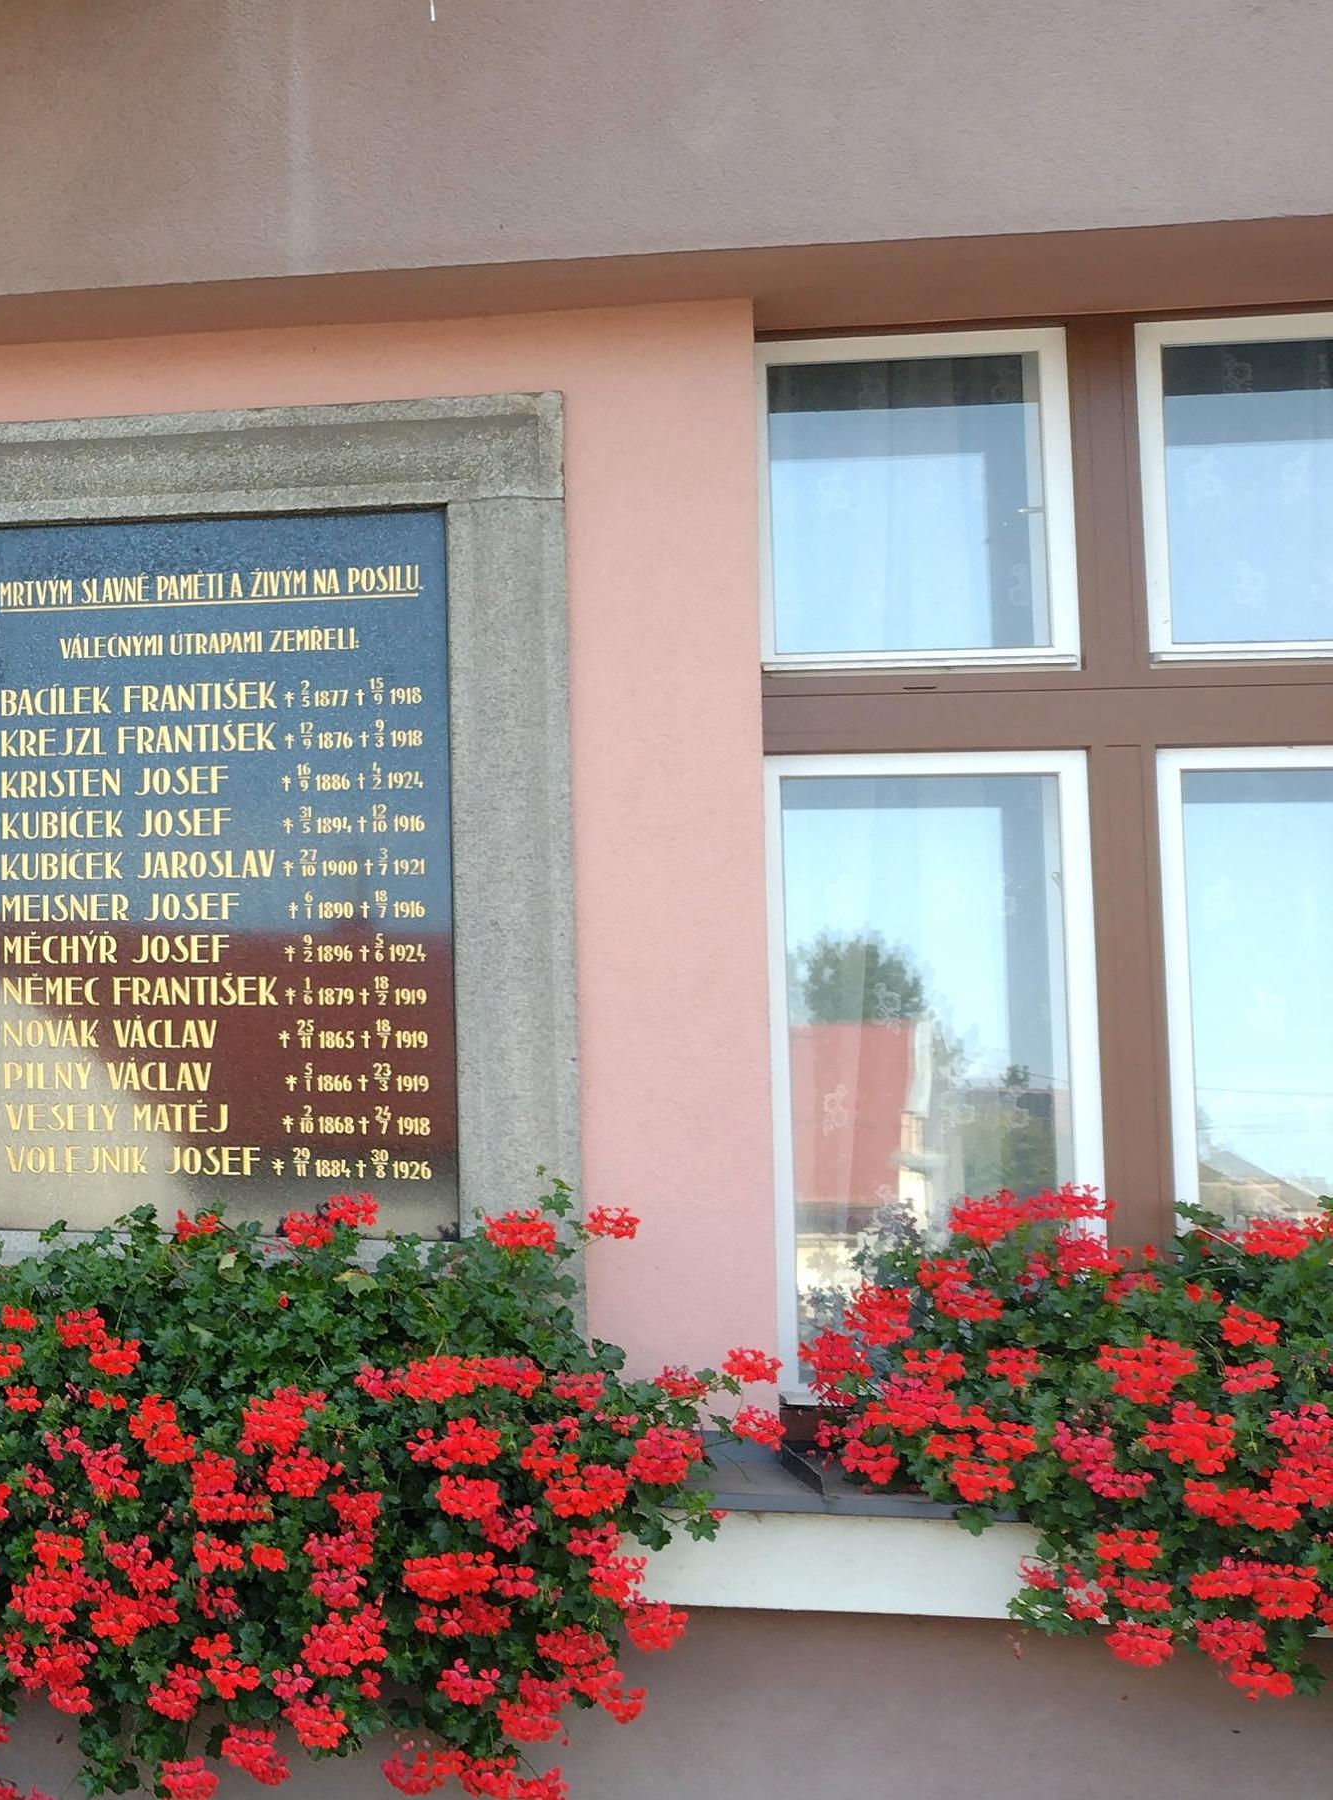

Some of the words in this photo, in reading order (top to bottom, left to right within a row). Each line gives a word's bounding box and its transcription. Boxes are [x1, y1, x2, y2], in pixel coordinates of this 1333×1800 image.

[0, 575, 73, 607] MRTVÝM
[81, 572, 150, 603] SLAVNÉ
[156, 568, 224, 600] PAMĚTI
[231, 572, 243, 598] A
[250, 566, 307, 598] ŽIVÝM
[313, 568, 340, 594] NA
[60, 632, 163, 659] VÁLEČNÝMI
[0, 683, 111, 716] BACÍLEK
[123, 678, 277, 713] FRANTIŠEK
[314, 689, 349, 707] 1877
[390, 687, 422, 705] 1918
[0, 727, 107, 757] KREJZL
[117, 720, 276, 754] FRANTIŠEK
[317, 732, 353, 749] 1876
[390, 730, 423, 747] 1918
[0, 767, 121, 799] KRISTEN
[135, 765, 229, 796] JOSEF
[316, 774, 350, 791] 1886
[387, 771, 424, 789] 1924
[1, 806, 123, 840] KUBÍČEK
[137, 807, 232, 837] JOSEF
[316, 816, 352, 833] 1894
[393, 815, 425, 832] 1916
[0, 849, 124, 880] KUBÍČEK
[138, 849, 276, 879] JAROSLAV
[322, 860, 357, 876] 1900
[393, 859, 425, 875] 1921
[1, 893, 129, 922] MEISNER
[144, 892, 240, 922] JOSEF
[318, 902, 353, 919] 1890
[393, 901, 426, 918] 1916
[3, 930, 118, 964] MĚCHÝŘ
[132, 934, 229, 963] JOSEF
[317, 945, 353, 962] 1896
[389, 944, 426, 962] 1924
[2, 973, 100, 1006] NĚMEC
[113, 973, 279, 1006] FRANTIŠEK
[318, 988, 354, 1006] 1879
[395, 988, 427, 1006] 1919
[2, 1013, 100, 1049] NOVÁK
[113, 1013, 217, 1049] VÁCLAV
[319, 1031, 354, 1049] 1865
[395, 1031, 428, 1049] 1919
[3, 1057, 92, 1090] PILNÝ
[107, 1057, 212, 1092] VÁCLAV
[317, 1074, 352, 1092] 1866
[396, 1075, 429, 1092] 1919
[132, 1099, 229, 1133] MATĚJ
[318, 1116, 354, 1134] 1868
[397, 1116, 431, 1136] 1918
[166, 1146, 261, 1176] JOSEF
[315, 1159, 351, 1178] 1884
[392, 1161, 432, 1180] 1926
